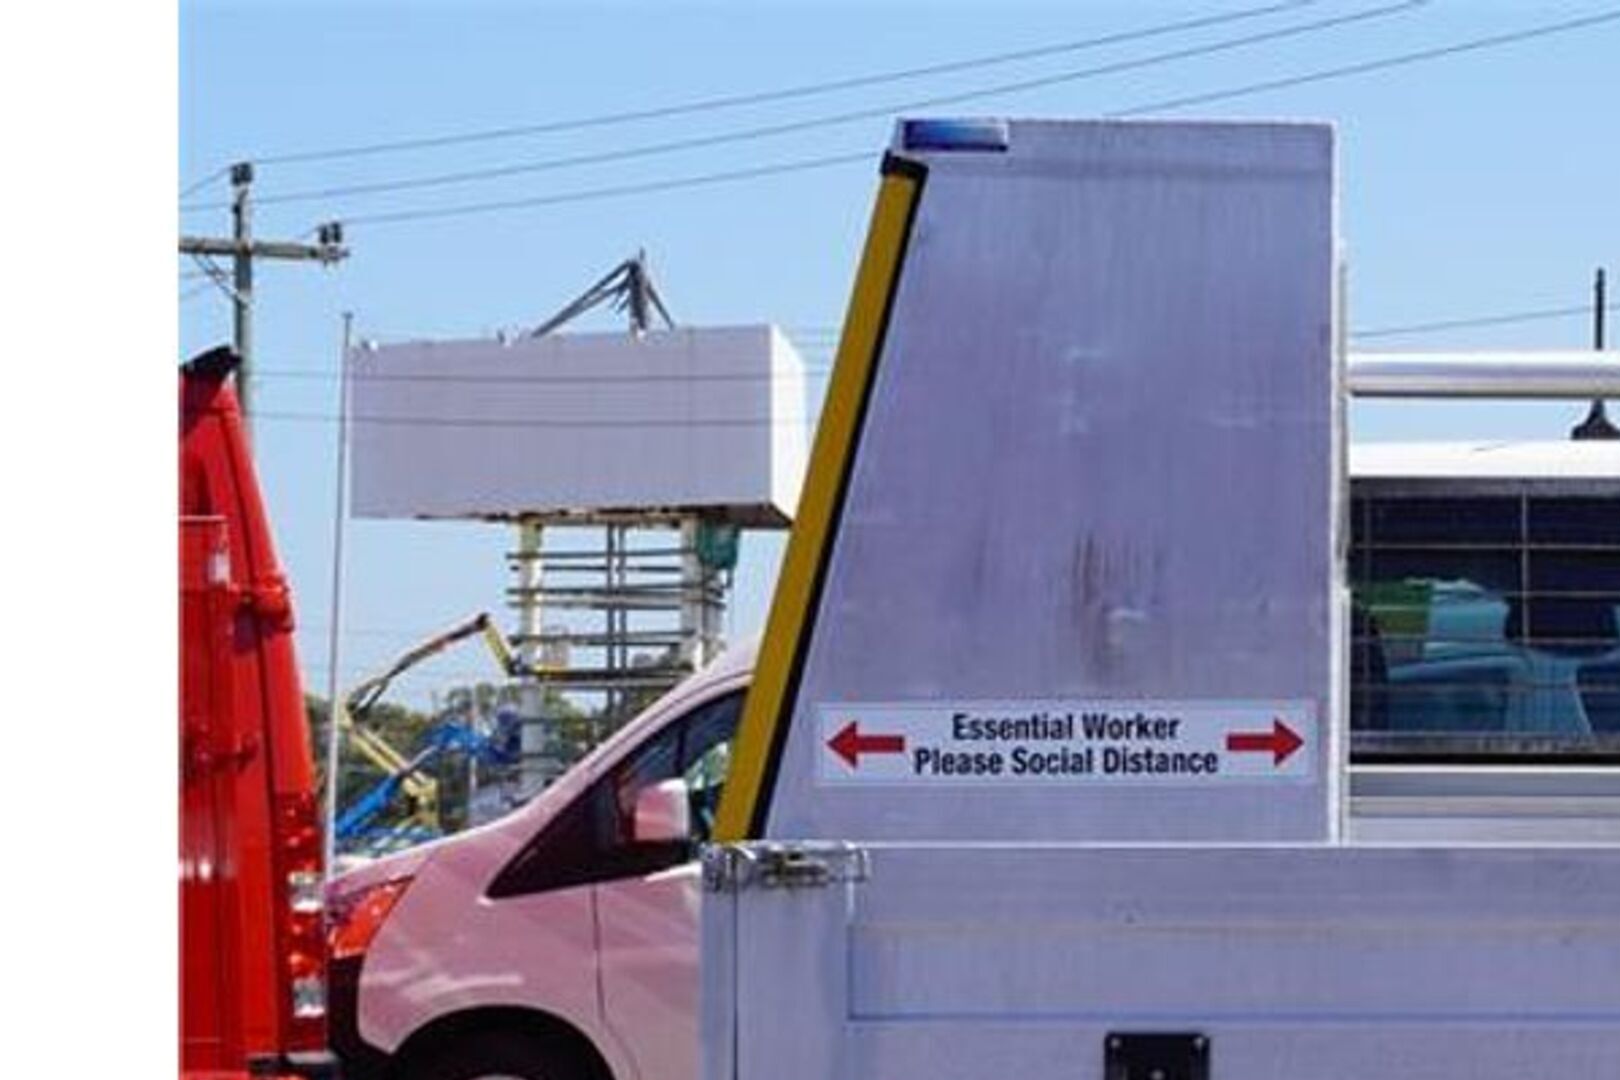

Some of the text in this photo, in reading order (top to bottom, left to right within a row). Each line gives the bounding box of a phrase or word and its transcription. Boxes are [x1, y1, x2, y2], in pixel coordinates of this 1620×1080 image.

[952, 713, 1180, 741] Essential Worker
[914, 747, 1219, 776] Please Social Distance
